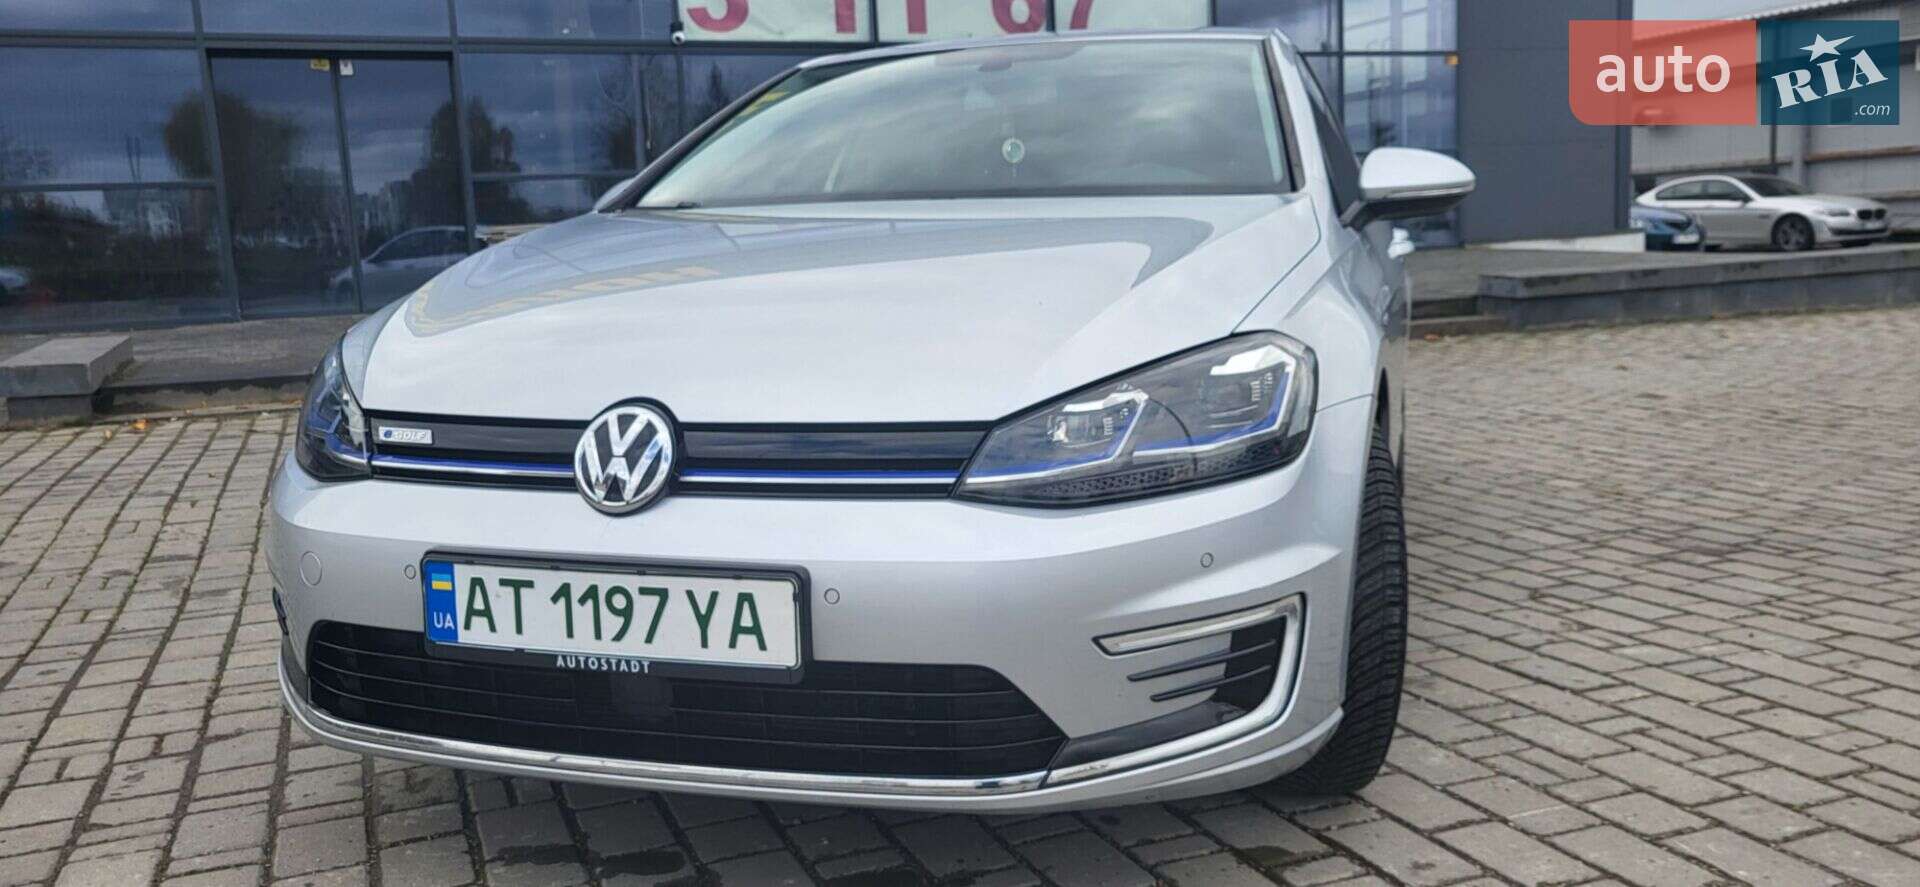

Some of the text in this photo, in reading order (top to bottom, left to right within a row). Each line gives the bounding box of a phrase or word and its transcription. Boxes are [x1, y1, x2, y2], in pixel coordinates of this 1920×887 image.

[433, 611, 455, 630] UA
[464, 577, 767, 651] AT 1197 YA
[556, 655, 650, 674] AUTOSTADT
